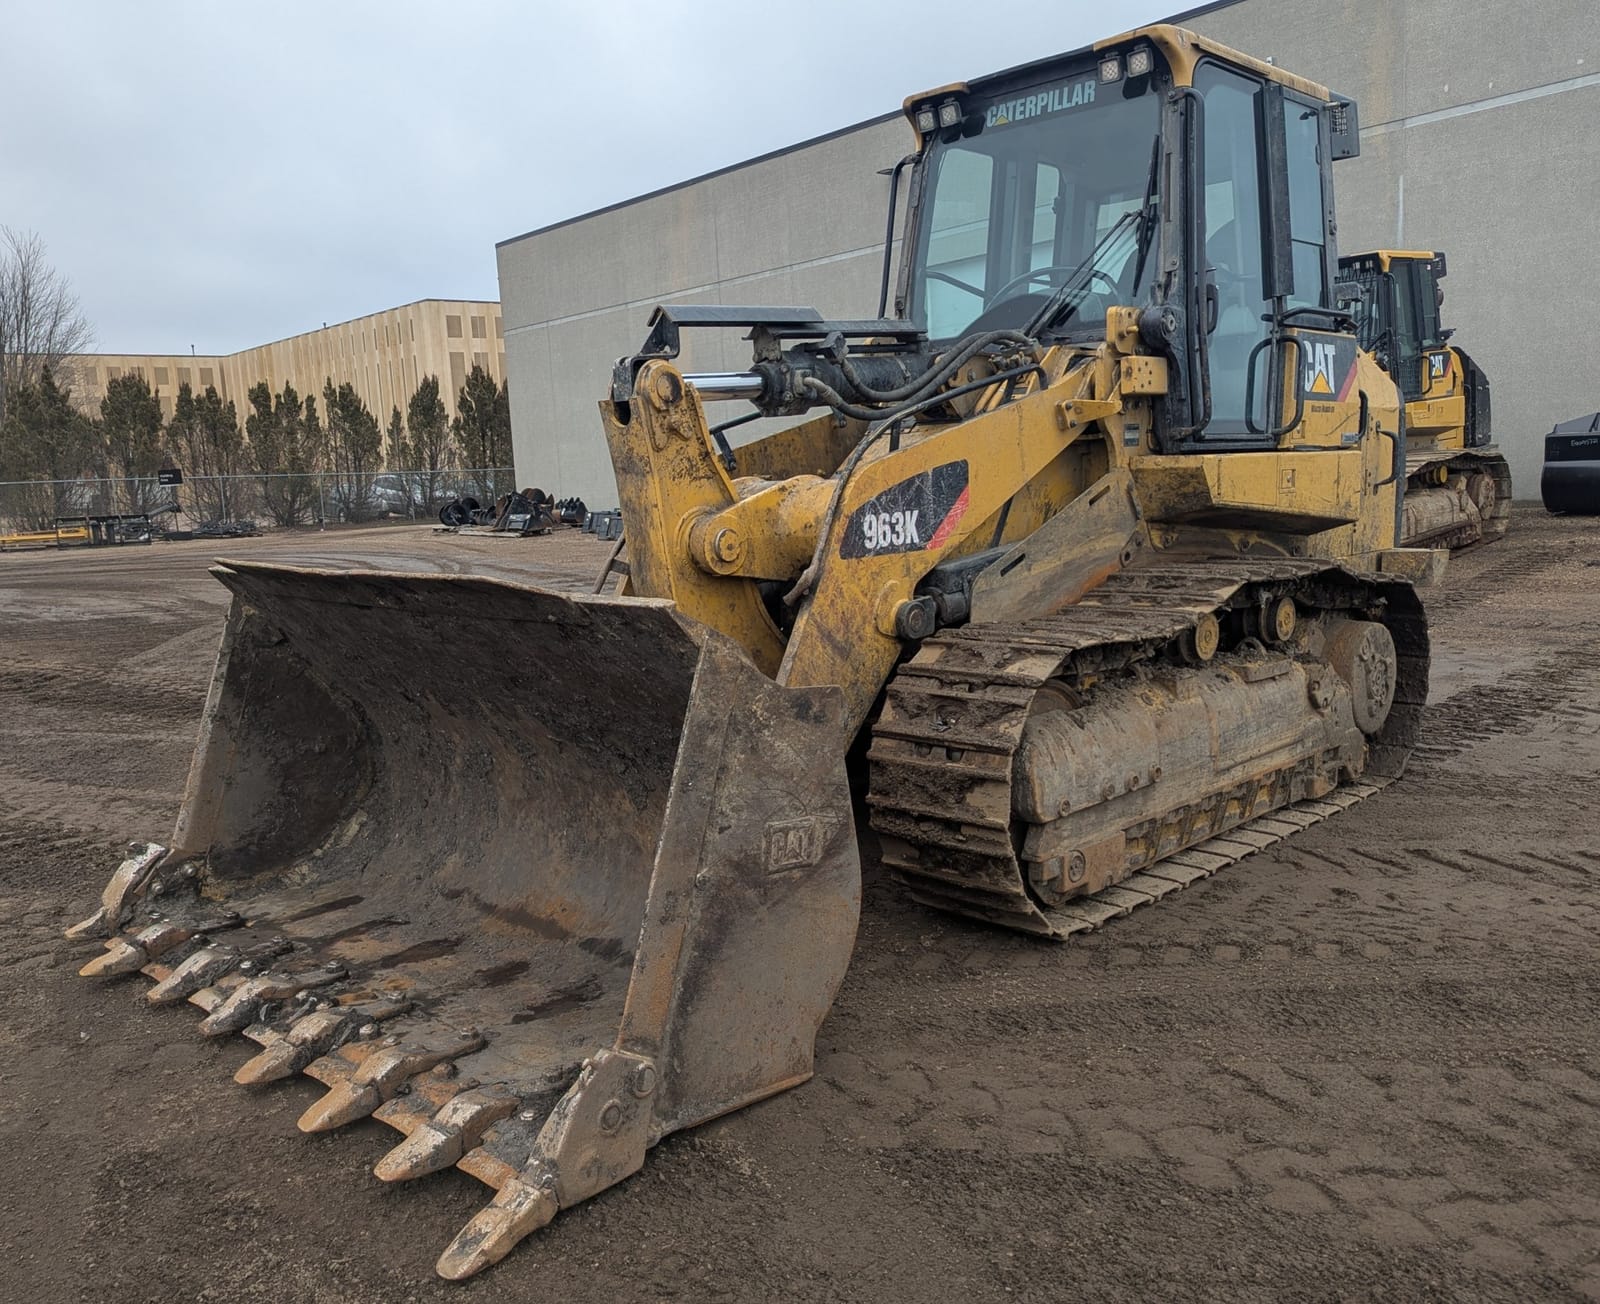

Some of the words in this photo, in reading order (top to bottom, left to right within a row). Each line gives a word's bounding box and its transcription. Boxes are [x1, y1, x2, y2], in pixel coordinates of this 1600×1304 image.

[986, 80, 1096, 127] CATERPILLAR
[1304, 341, 1336, 394] CAT
[863, 510, 919, 549] 963K
